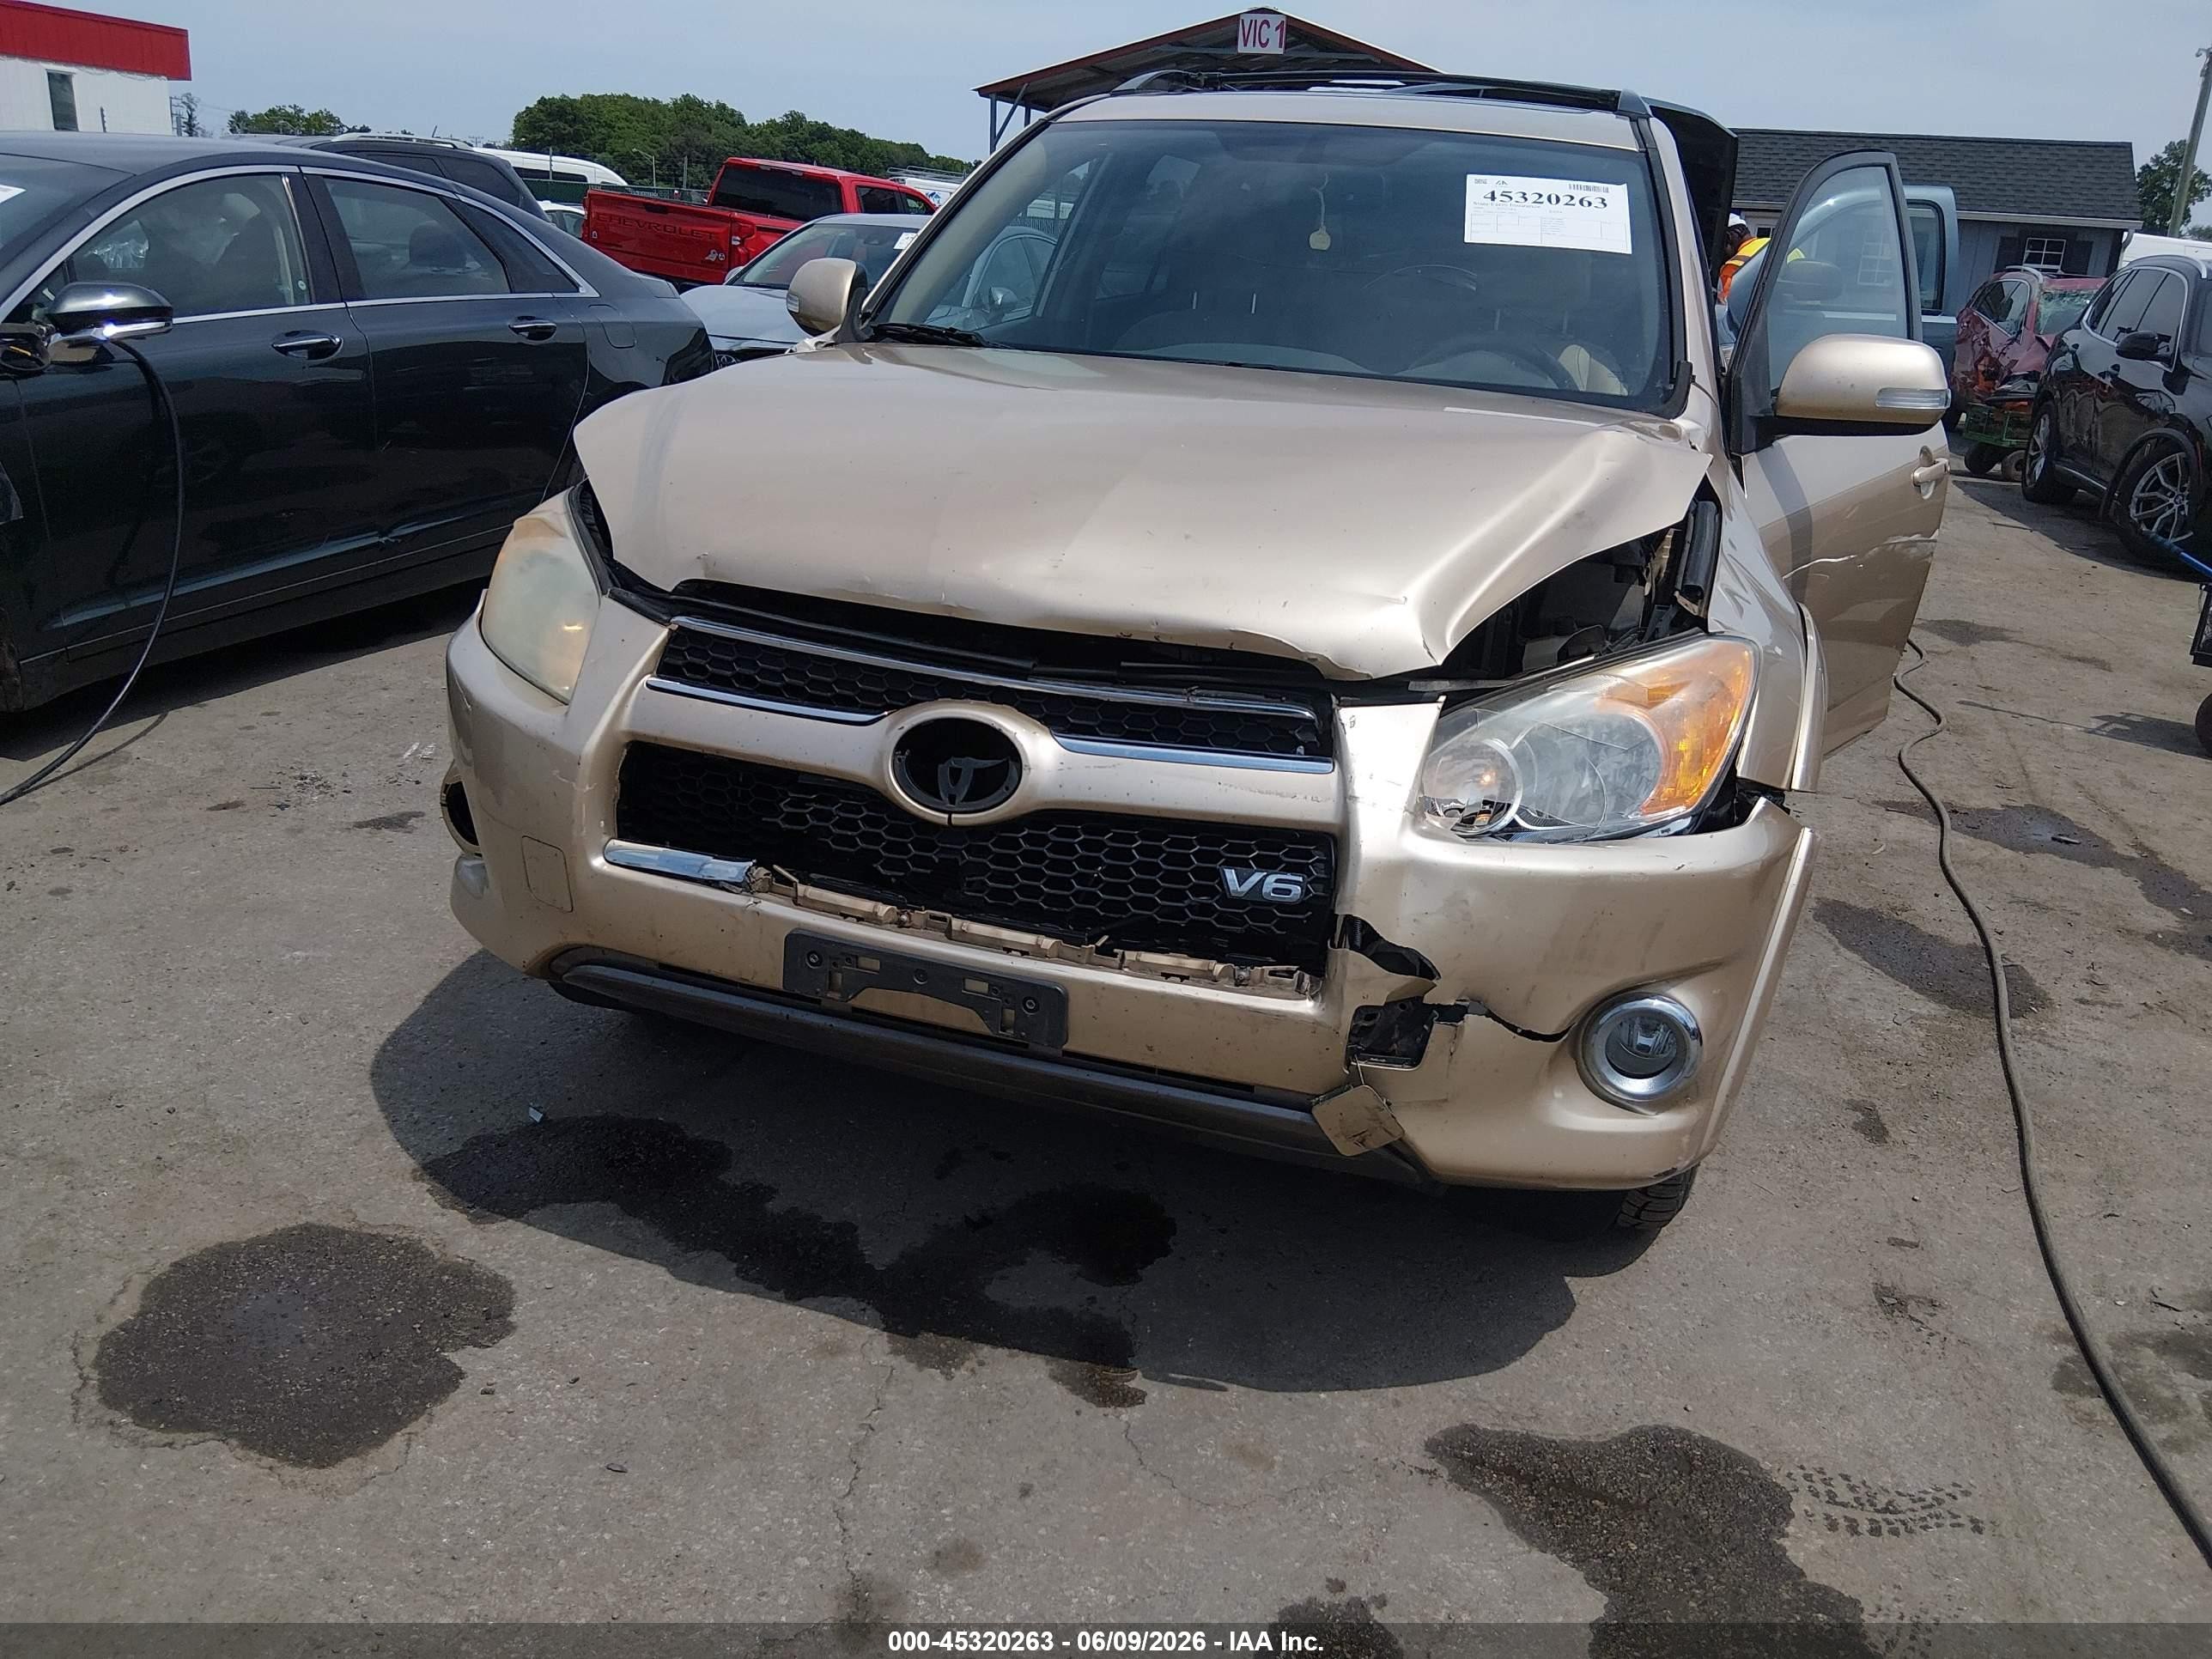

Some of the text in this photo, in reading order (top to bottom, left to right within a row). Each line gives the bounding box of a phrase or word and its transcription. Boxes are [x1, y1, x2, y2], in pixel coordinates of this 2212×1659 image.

[1241, 19, 1285, 49] VIC 1
[1483, 190, 1607, 209] 45320263
[597, 214, 715, 240] CHEVROLET
[1223, 868, 1304, 902] V6
